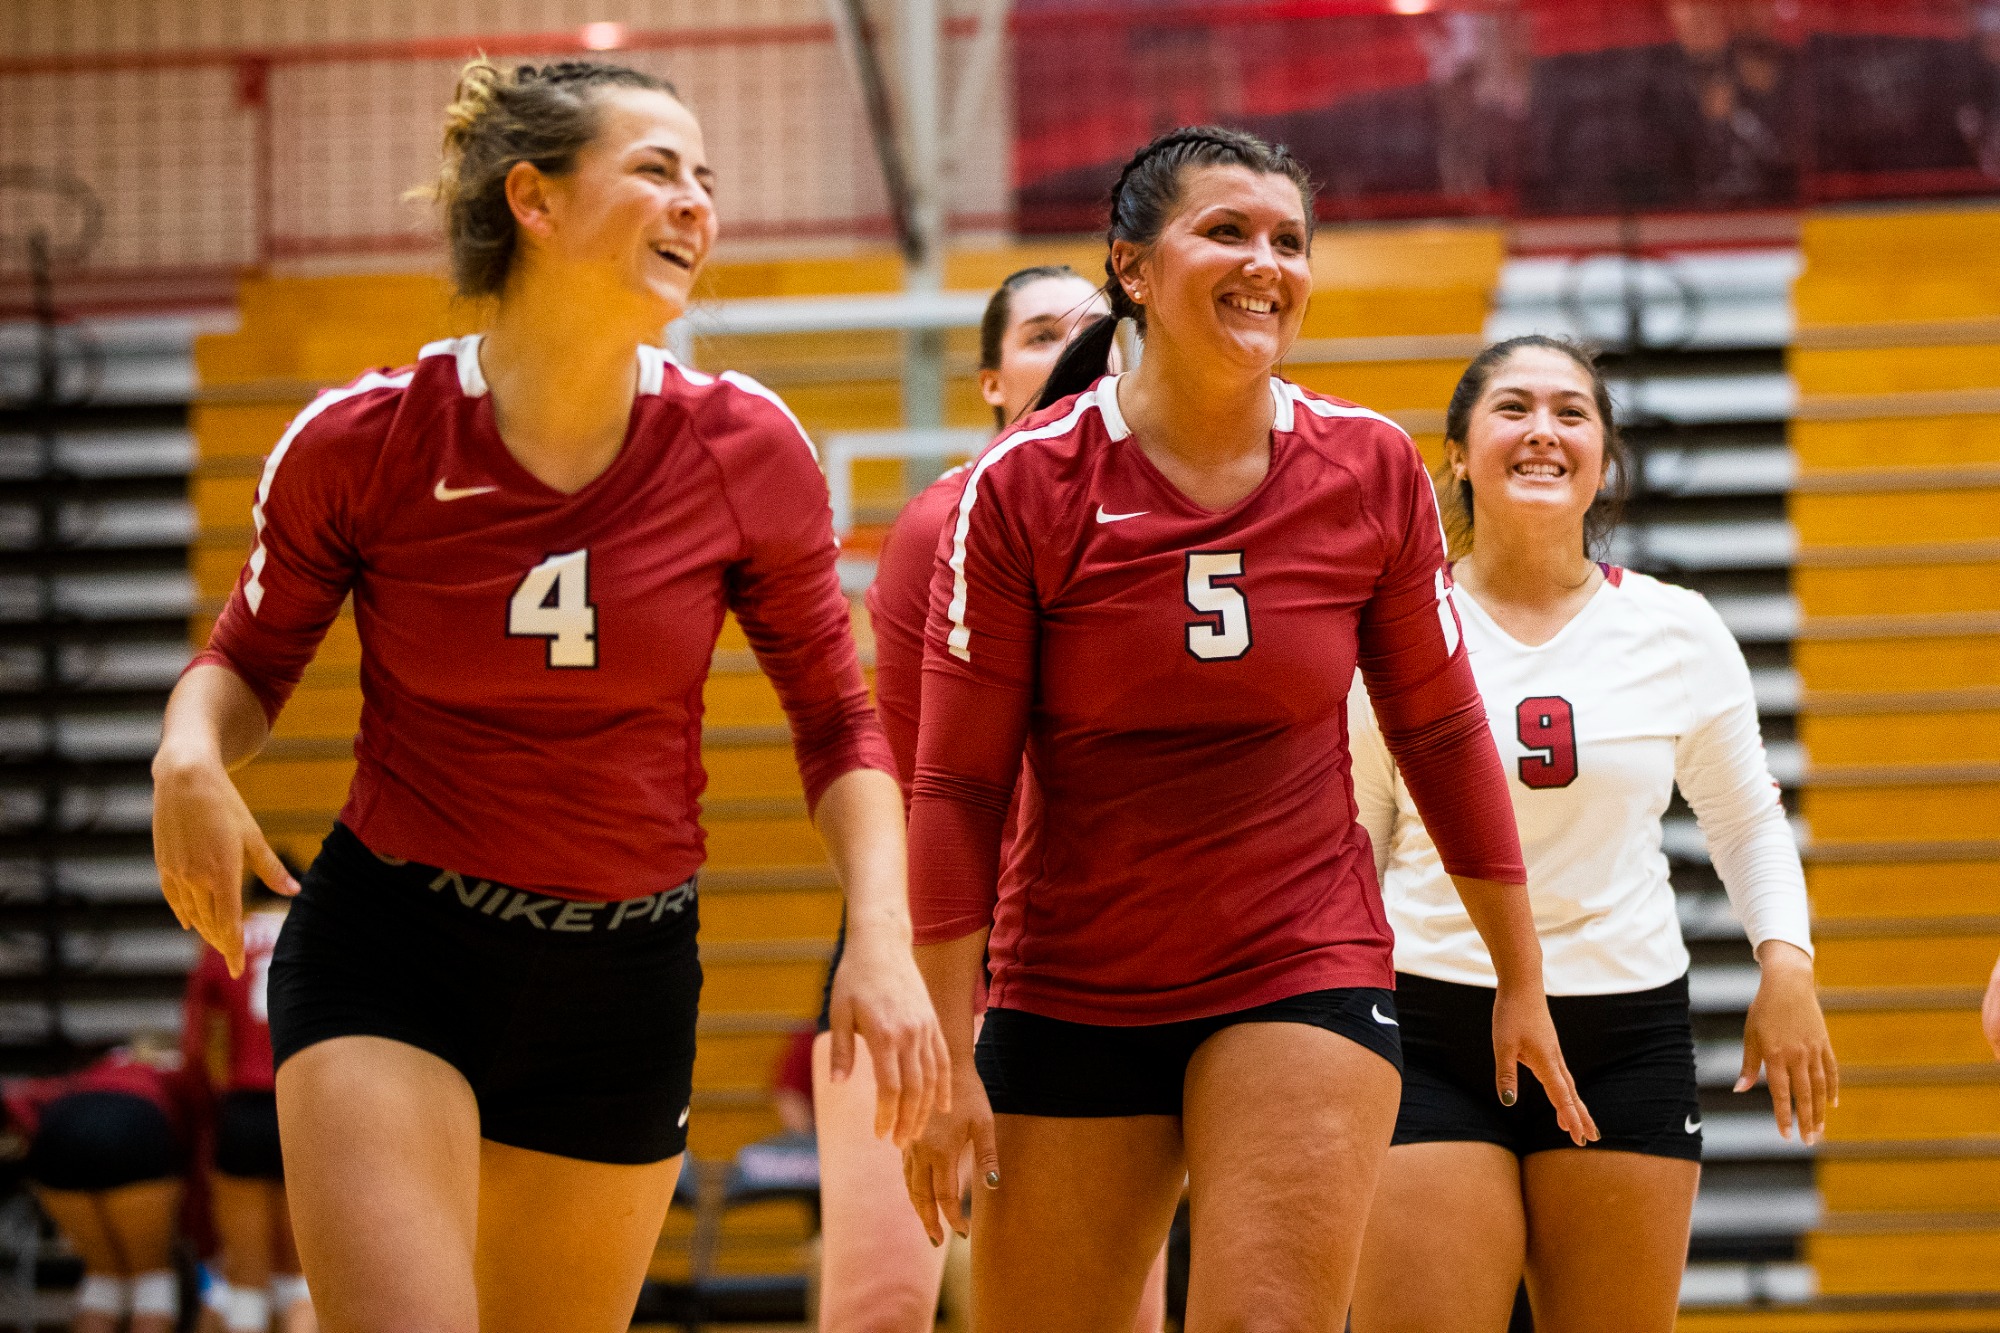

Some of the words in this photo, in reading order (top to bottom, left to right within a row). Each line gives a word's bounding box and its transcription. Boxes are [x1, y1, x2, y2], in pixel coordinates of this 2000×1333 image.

[505, 549, 598, 669] 4
[1184, 550, 1253, 662] 5
[1516, 696, 1578, 789] 9
[428, 869, 607, 932] NIKE
